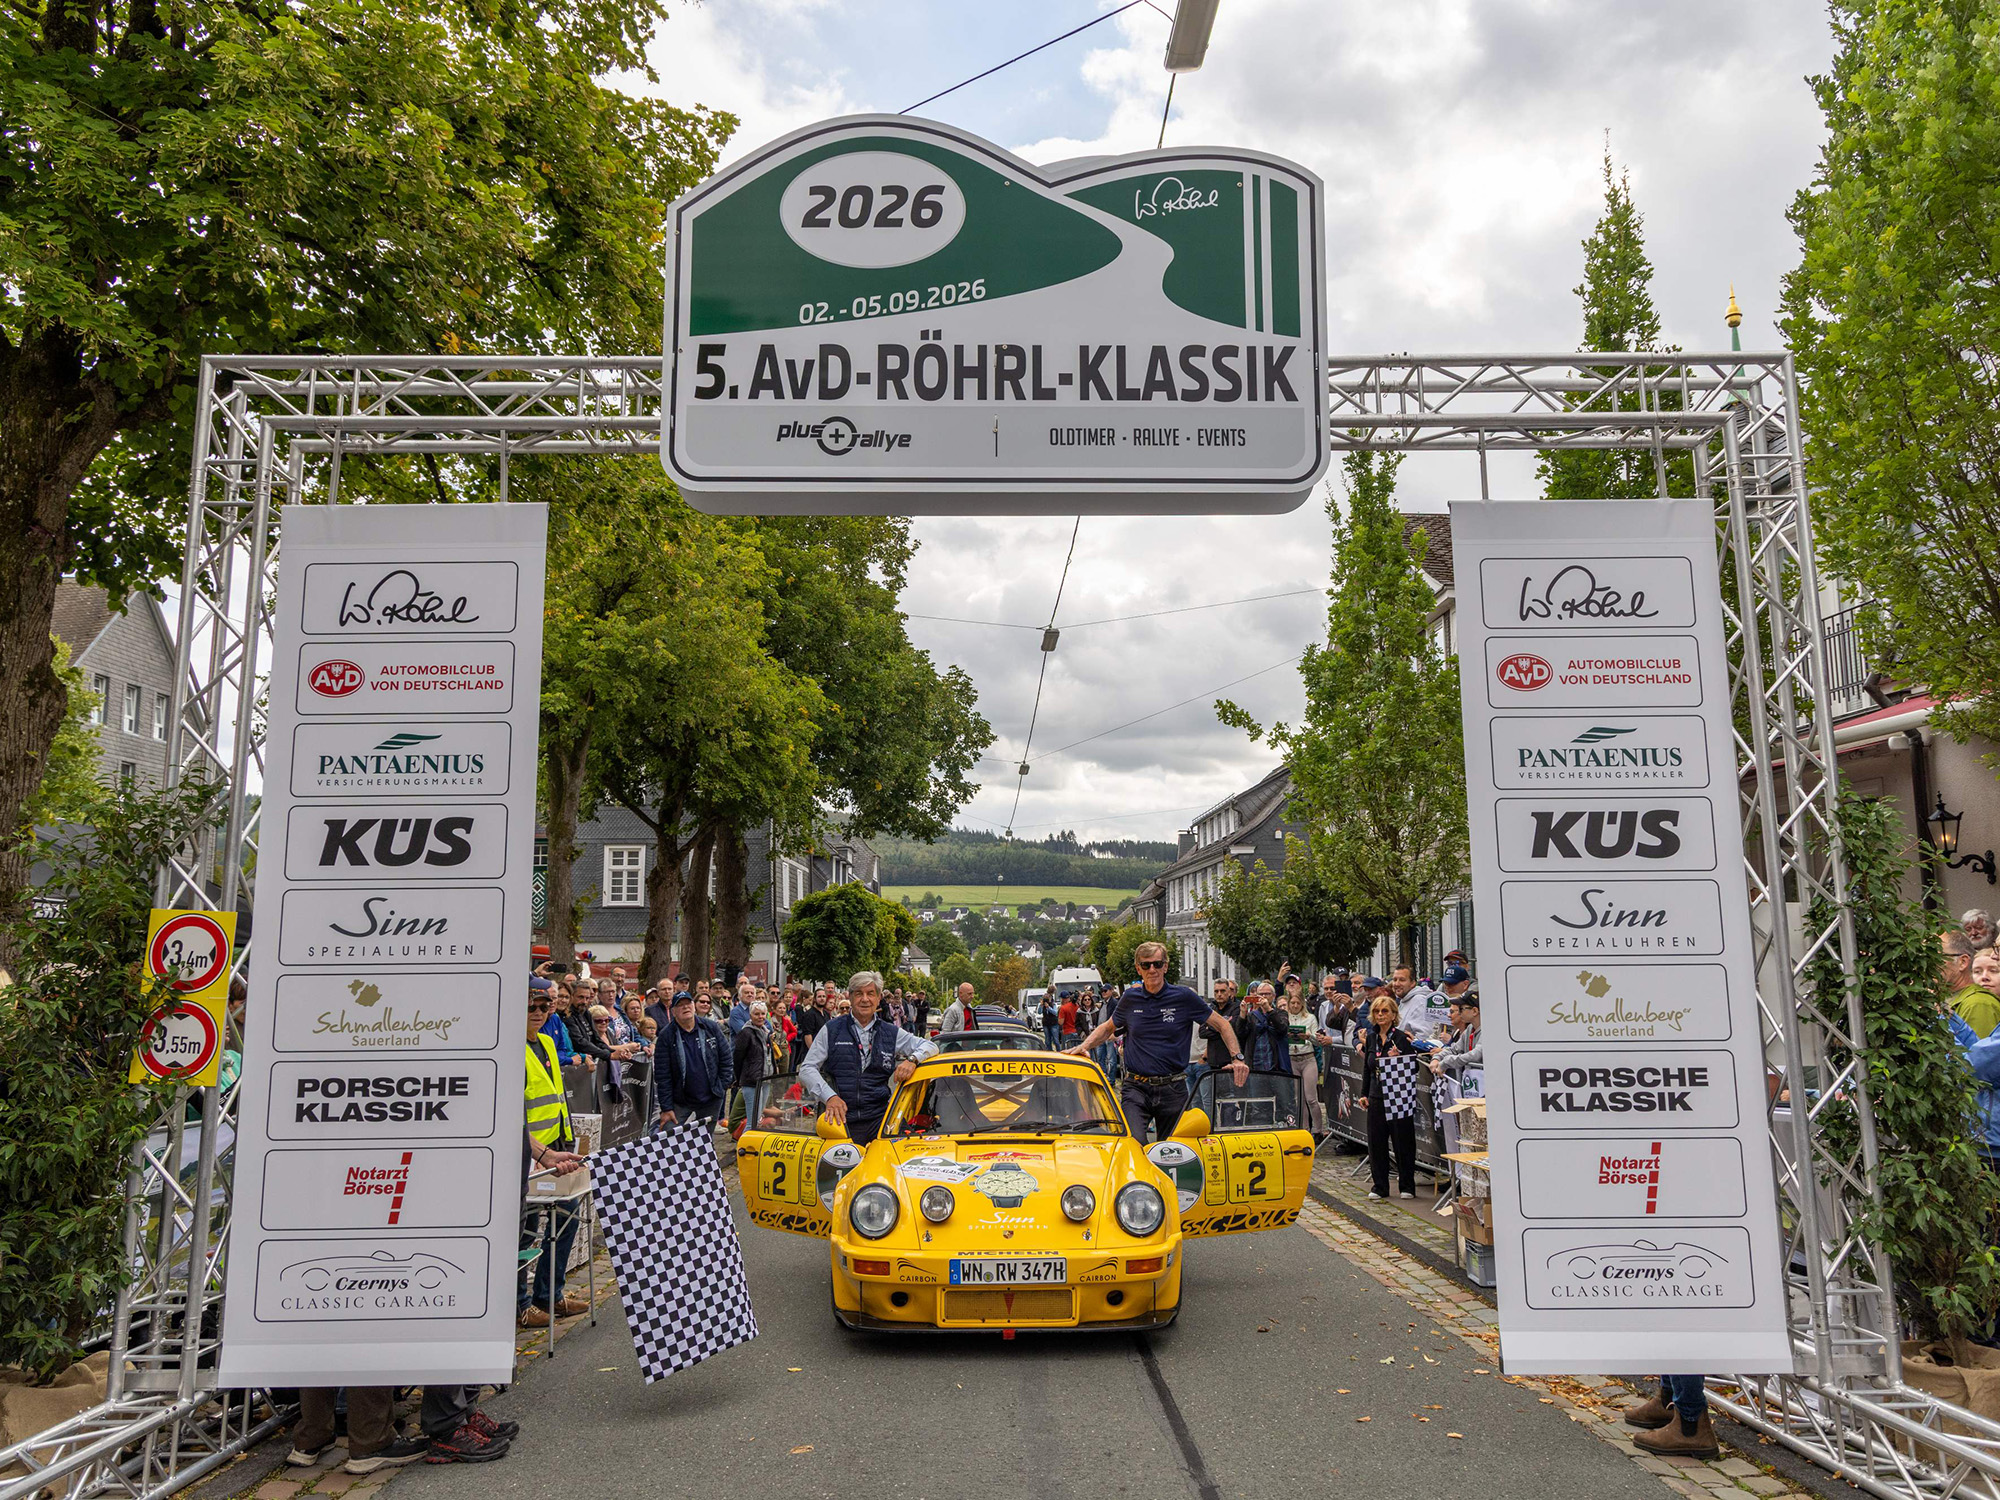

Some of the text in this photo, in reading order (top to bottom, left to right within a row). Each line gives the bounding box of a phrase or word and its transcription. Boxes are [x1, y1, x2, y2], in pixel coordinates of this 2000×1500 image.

[800, 185, 946, 229] 2026
[799, 303, 834, 325] 02.
[851, 278, 986, 319] 05.09.2026
[695, 329, 1299, 402] 5. AvD-RÖHRL-KLASSIK
[1049, 427, 1247, 448] OLDTIMER RALLYE EVENTS
[380, 664, 495, 676] AUTOMOBILCLUB
[1567, 658, 1681, 670] AUTOMOBILCLUB
[370, 679, 504, 692] VON DEUTSCHLAND
[1559, 673, 1692, 685] VON DEUTSCHLAND
[317, 753, 484, 776] PANTAENIUS
[1517, 747, 1683, 768] PANTAENIUS
[317, 777, 484, 787] VERSICHERUNGSMAKLER
[1518, 770, 1684, 779] VERSICHERUNGSMAKLER
[318, 816, 475, 867] KÜS
[1531, 809, 1681, 859] KÜS
[1549, 888, 1668, 929] Sinn
[329, 896, 449, 938] Sinn
[1532, 936, 1696, 948] SPEZIALUHREN
[308, 944, 475, 958] SPEZIALUHREN
[1587, 1025, 1655, 1038] Sauerland
[351, 1034, 420, 1047] Sauerland
[1538, 1067, 1709, 1089] PORSCHE
[297, 1076, 470, 1099] PORSCHE
[1541, 1091, 1693, 1113] KLASSIK
[295, 1101, 449, 1123] KLASSIK
[770, 1136, 800, 1152] lloret
[1599, 1156, 1660, 1172] Notarzt
[346, 1166, 409, 1182] Notarzt
[773, 1161, 786, 1197] 2
[1248, 1160, 1267, 1196] 2
[1599, 1171, 1647, 1185] Börse
[344, 1181, 394, 1196] Börse
[763, 1181, 770, 1195] H
[1236, 1183, 1245, 1198] H
[978, 1211, 1035, 1224] Sinn
[899, 1274, 938, 1284] CAIRBON
[961, 1262, 983, 1283] WN
[995, 1262, 1018, 1283] RW
[1021, 1260, 1066, 1283] 347H
[1079, 1273, 1118, 1283] CAIRBON
[1602, 1265, 1675, 1281] Czernys
[335, 1276, 410, 1292] Czernys
[1551, 1283, 1724, 1298] CLASSIC GARAGE
[281, 1294, 457, 1310] CLASSIC GARAGE
